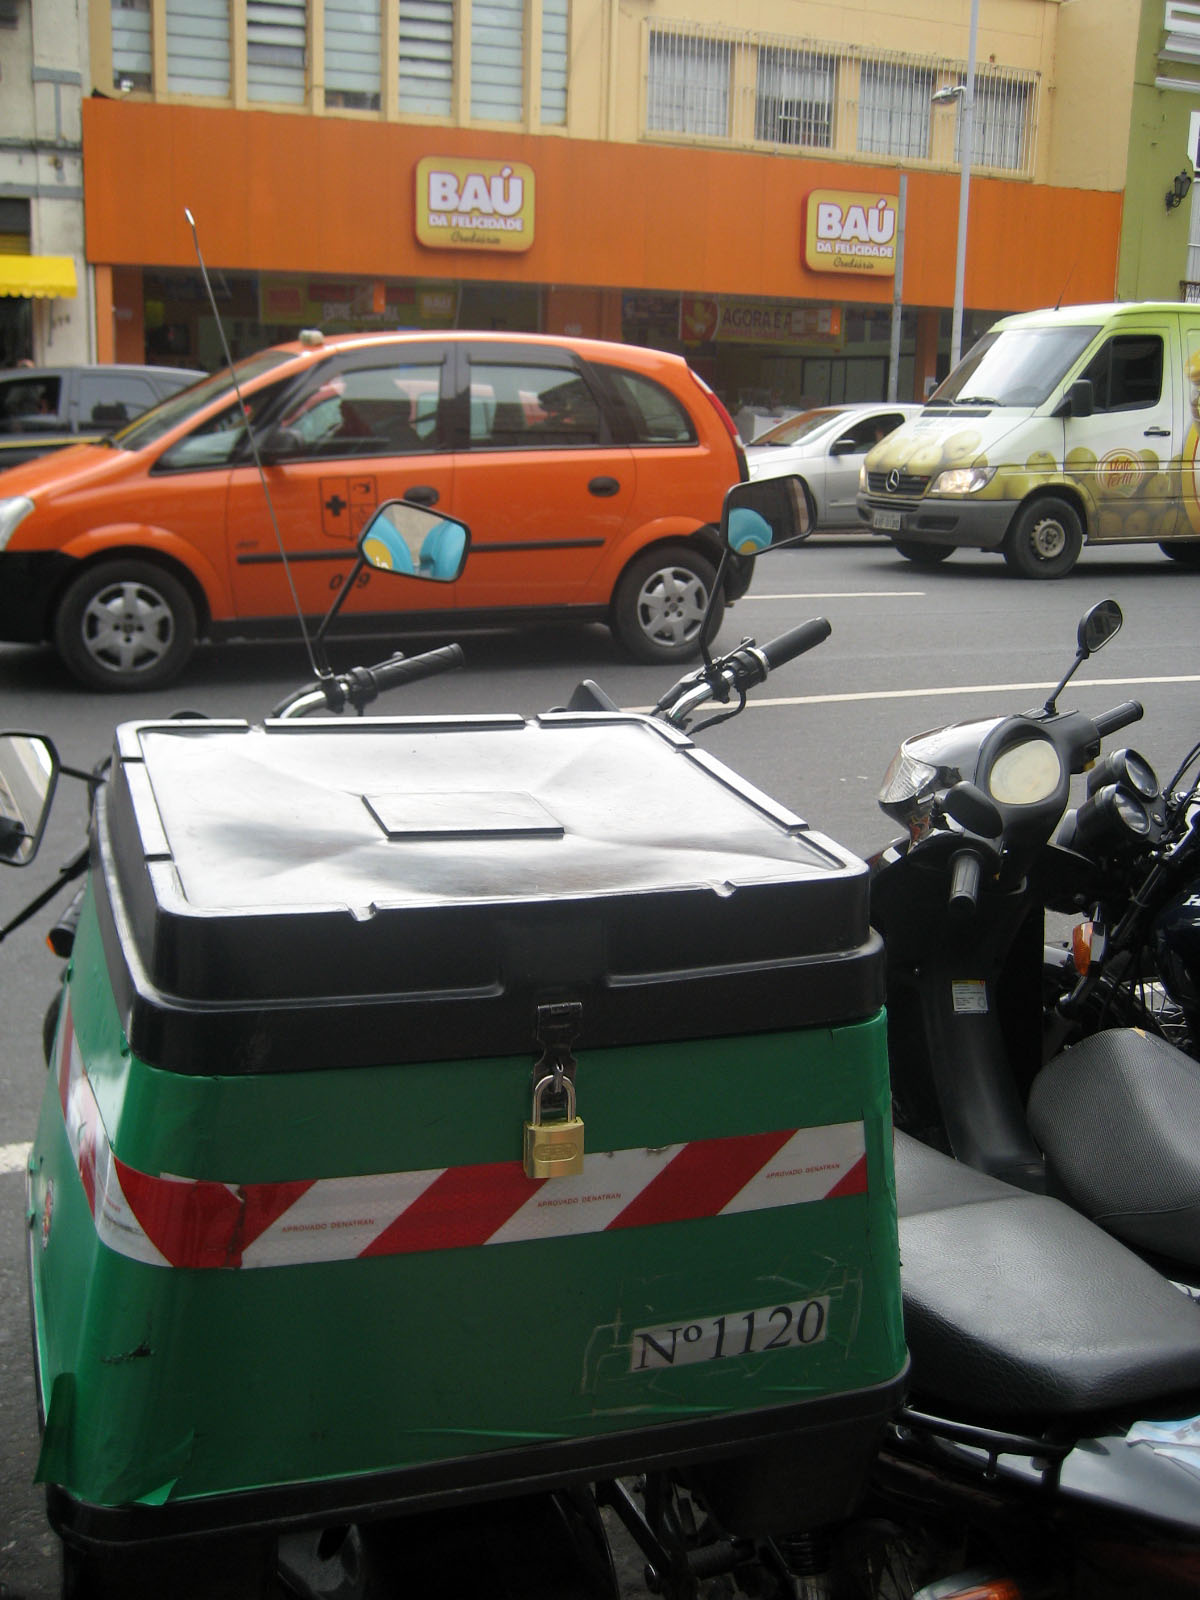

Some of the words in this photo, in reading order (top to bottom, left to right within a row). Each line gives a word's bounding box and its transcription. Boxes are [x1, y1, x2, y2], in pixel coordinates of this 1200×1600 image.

[429, 167, 523, 216] BAÚ
[429, 214, 448, 226] DA
[452, 215, 523, 231] FELICIDADE
[817, 199, 895, 244] BAÚ
[816, 242, 832, 253] DA
[835, 243, 893, 258] FELICIDADE
[765, 1168, 803, 1179] APROVADO
[805, 1163, 840, 1173] DENATRAN
[537, 1197, 579, 1208] APROVADO
[581, 1193, 622, 1204] DENATRAN
[282, 1223, 327, 1233] APROVADO
[330, 1219, 374, 1230] DENATRAN
